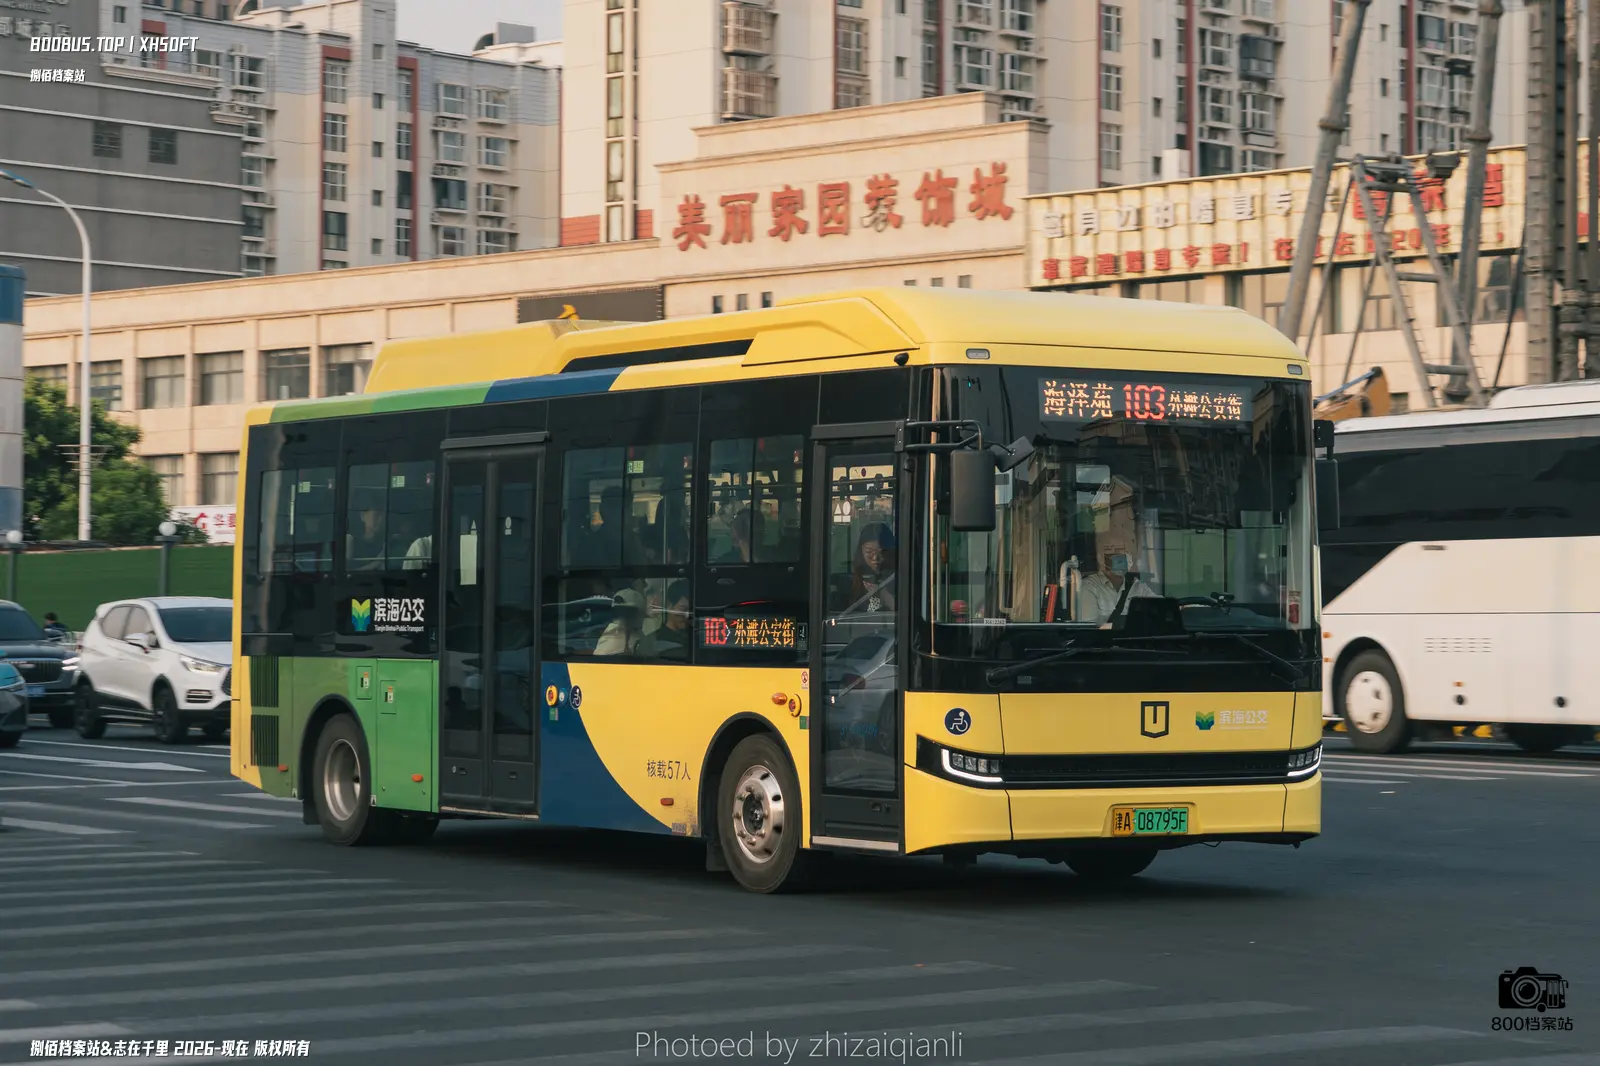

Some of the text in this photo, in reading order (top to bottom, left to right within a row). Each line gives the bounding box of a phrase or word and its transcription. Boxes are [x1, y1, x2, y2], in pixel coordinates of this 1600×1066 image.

[672, 161, 1015, 252] 美丽家园装饰城
[1122, 383, 1166, 421] 103
[374, 597, 425, 622] 滨海公交
[704, 617, 727, 645] 103
[1219, 709, 1269, 725] 滨海公交
[646, 759, 692, 781] 核载57人
